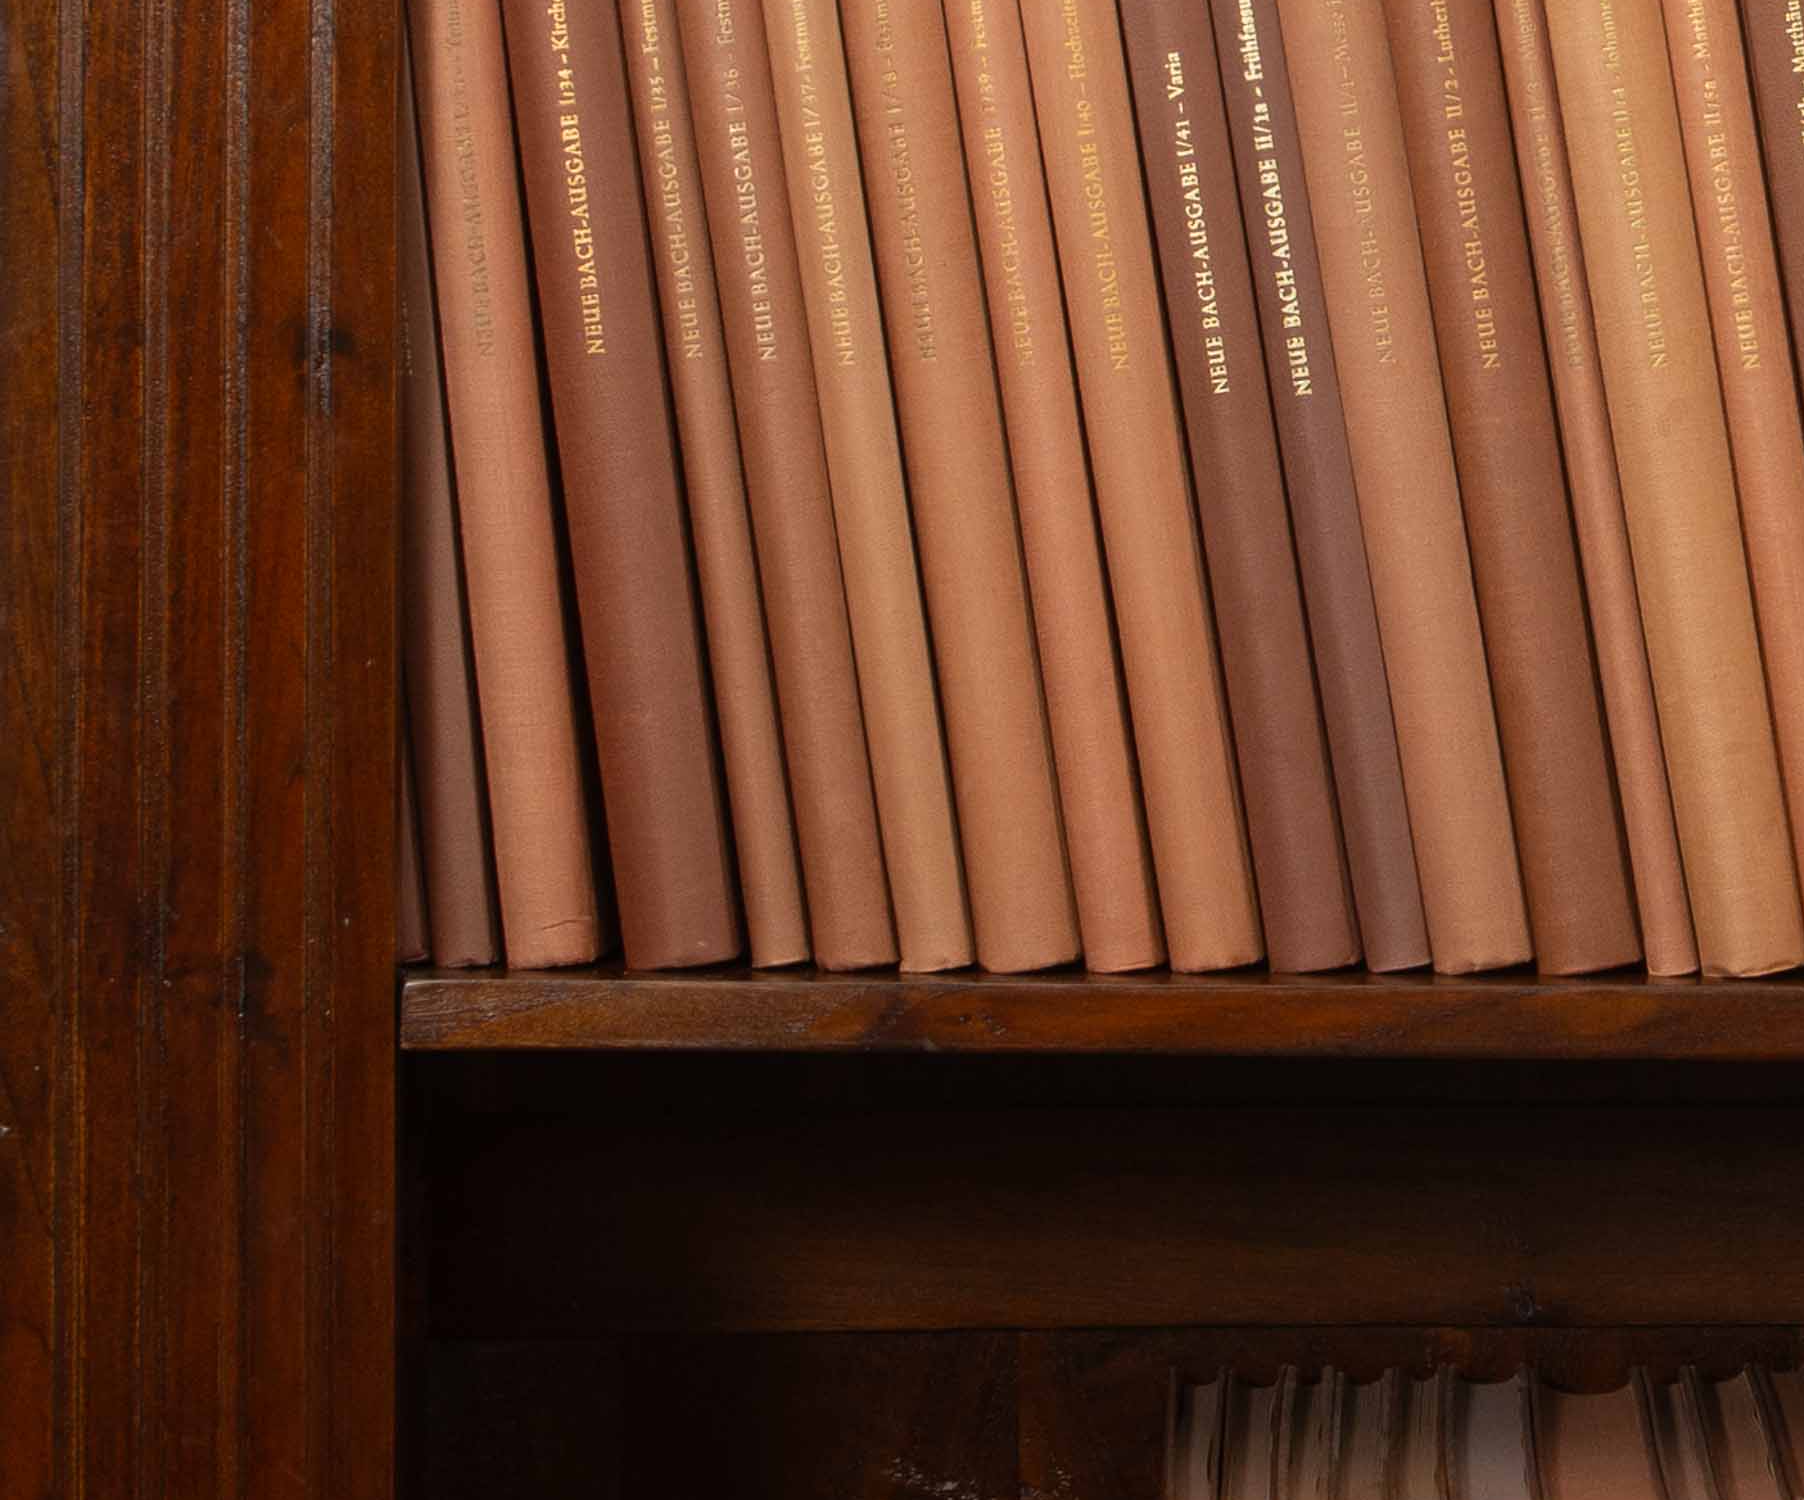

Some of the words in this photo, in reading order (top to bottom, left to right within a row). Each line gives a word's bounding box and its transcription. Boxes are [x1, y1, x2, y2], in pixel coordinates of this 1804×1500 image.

[1163, 51, 1185, 100] Varia
[1174, 119, 1194, 157] I/41
[1252, 101, 1274, 150] II/1a
[559, 113, 598, 289] BACH-AUSGABE
[1178, 161, 1220, 329] BACH-AUSGABE
[1257, 158, 1301, 328] BACH-AUSGABE
[580, 292, 606, 354] NEUE
[1204, 335, 1230, 394] NEUE
[1285, 335, 1313, 396] NEUE
